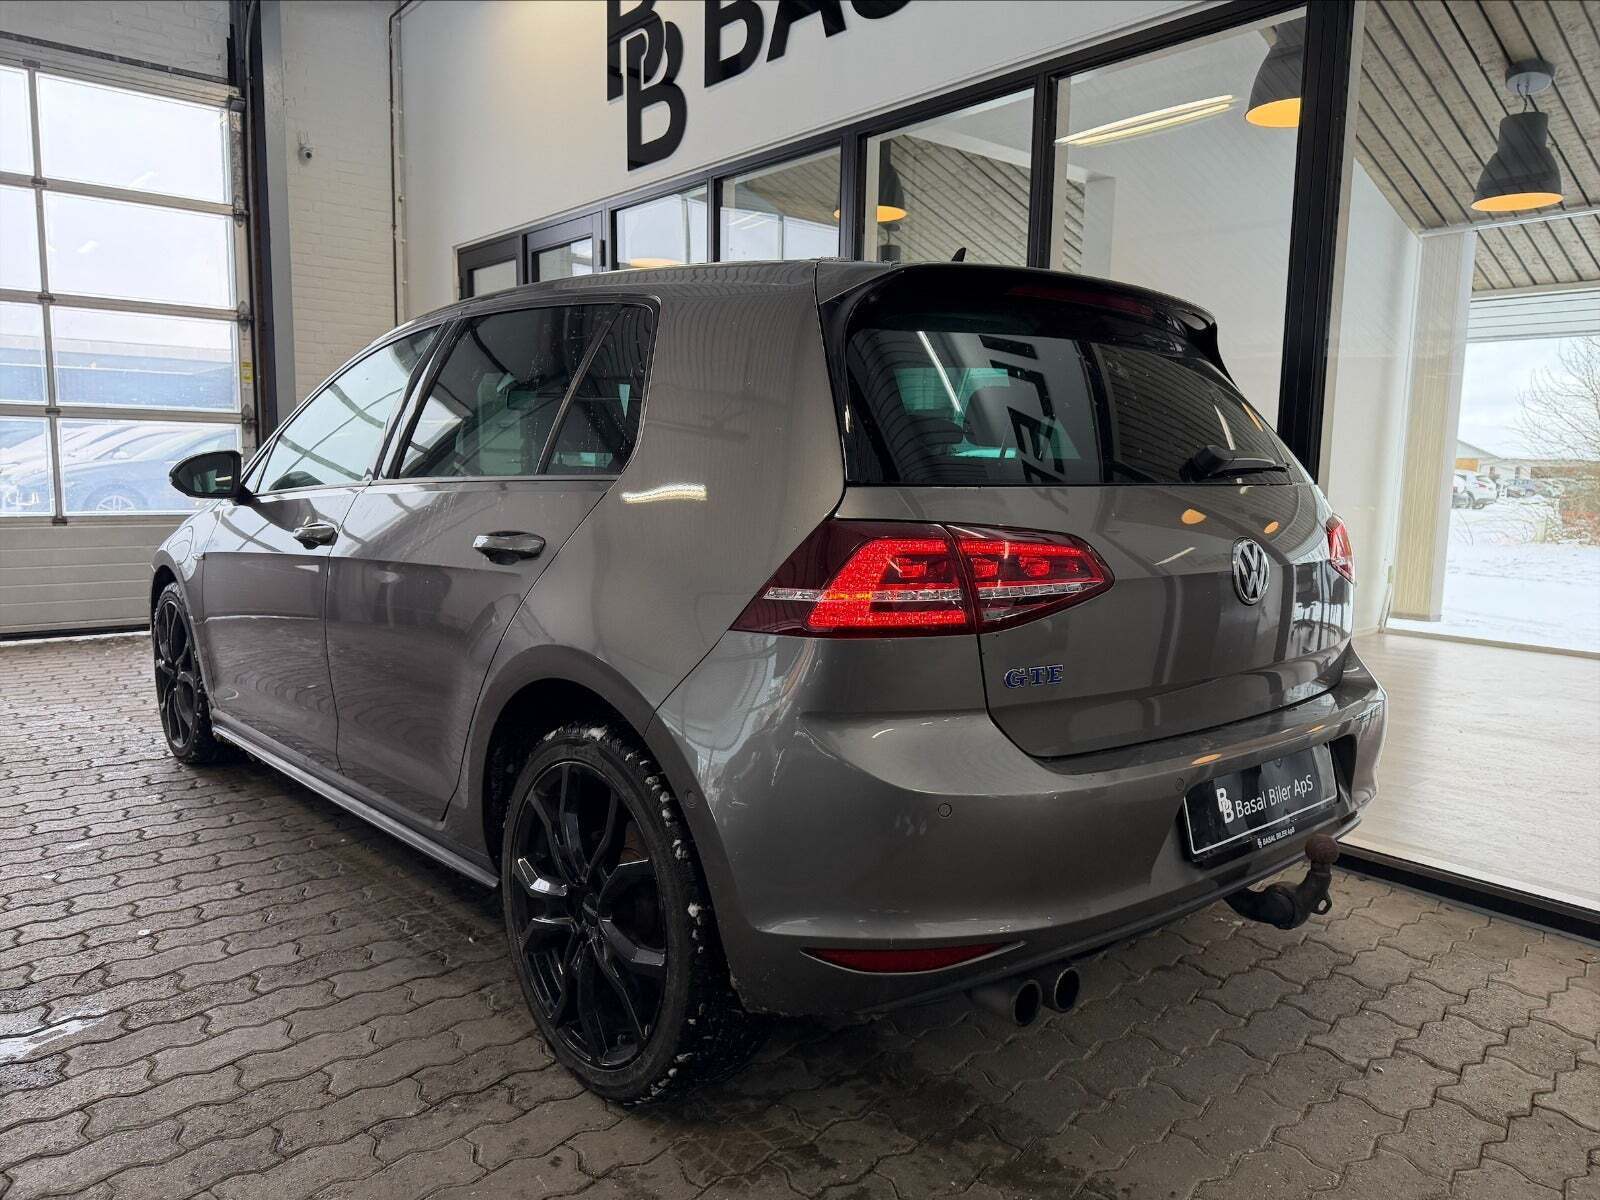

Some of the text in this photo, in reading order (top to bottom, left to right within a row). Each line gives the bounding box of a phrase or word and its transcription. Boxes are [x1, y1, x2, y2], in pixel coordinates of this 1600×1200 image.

[1004, 664, 1063, 688] GTE
[1235, 791, 1267, 818] Basal
[1268, 785, 1291, 806] Biler
[1294, 774, 1313, 798] ApS
